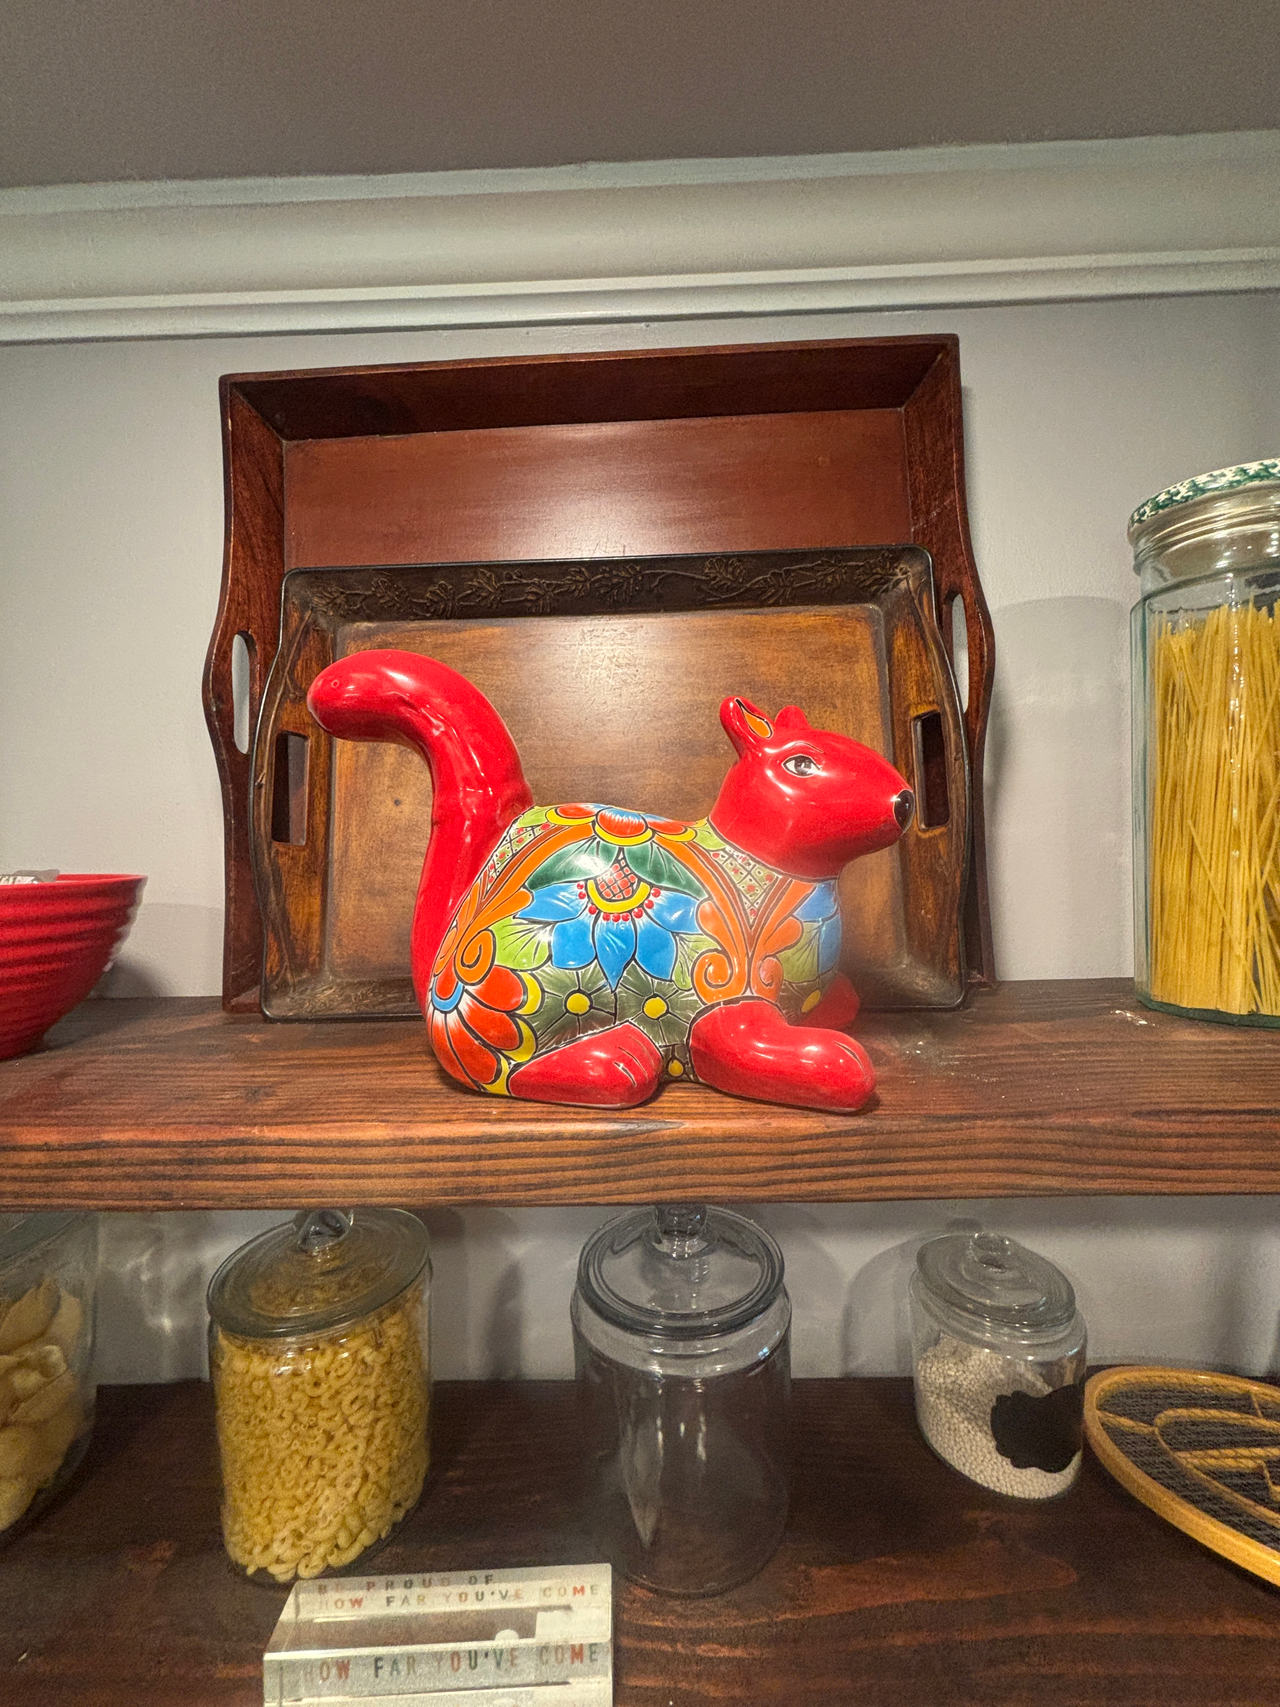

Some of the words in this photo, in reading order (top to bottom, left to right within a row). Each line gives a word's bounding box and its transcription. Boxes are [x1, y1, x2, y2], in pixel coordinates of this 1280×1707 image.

[468, 1574, 494, 1586] OF
[385, 1594, 427, 1607] FAR
[542, 1583, 600, 1598] COME
[373, 1654, 416, 1679] FAR
[432, 1647, 519, 1673] YOU'VE
[539, 1643, 599, 1666] COME
